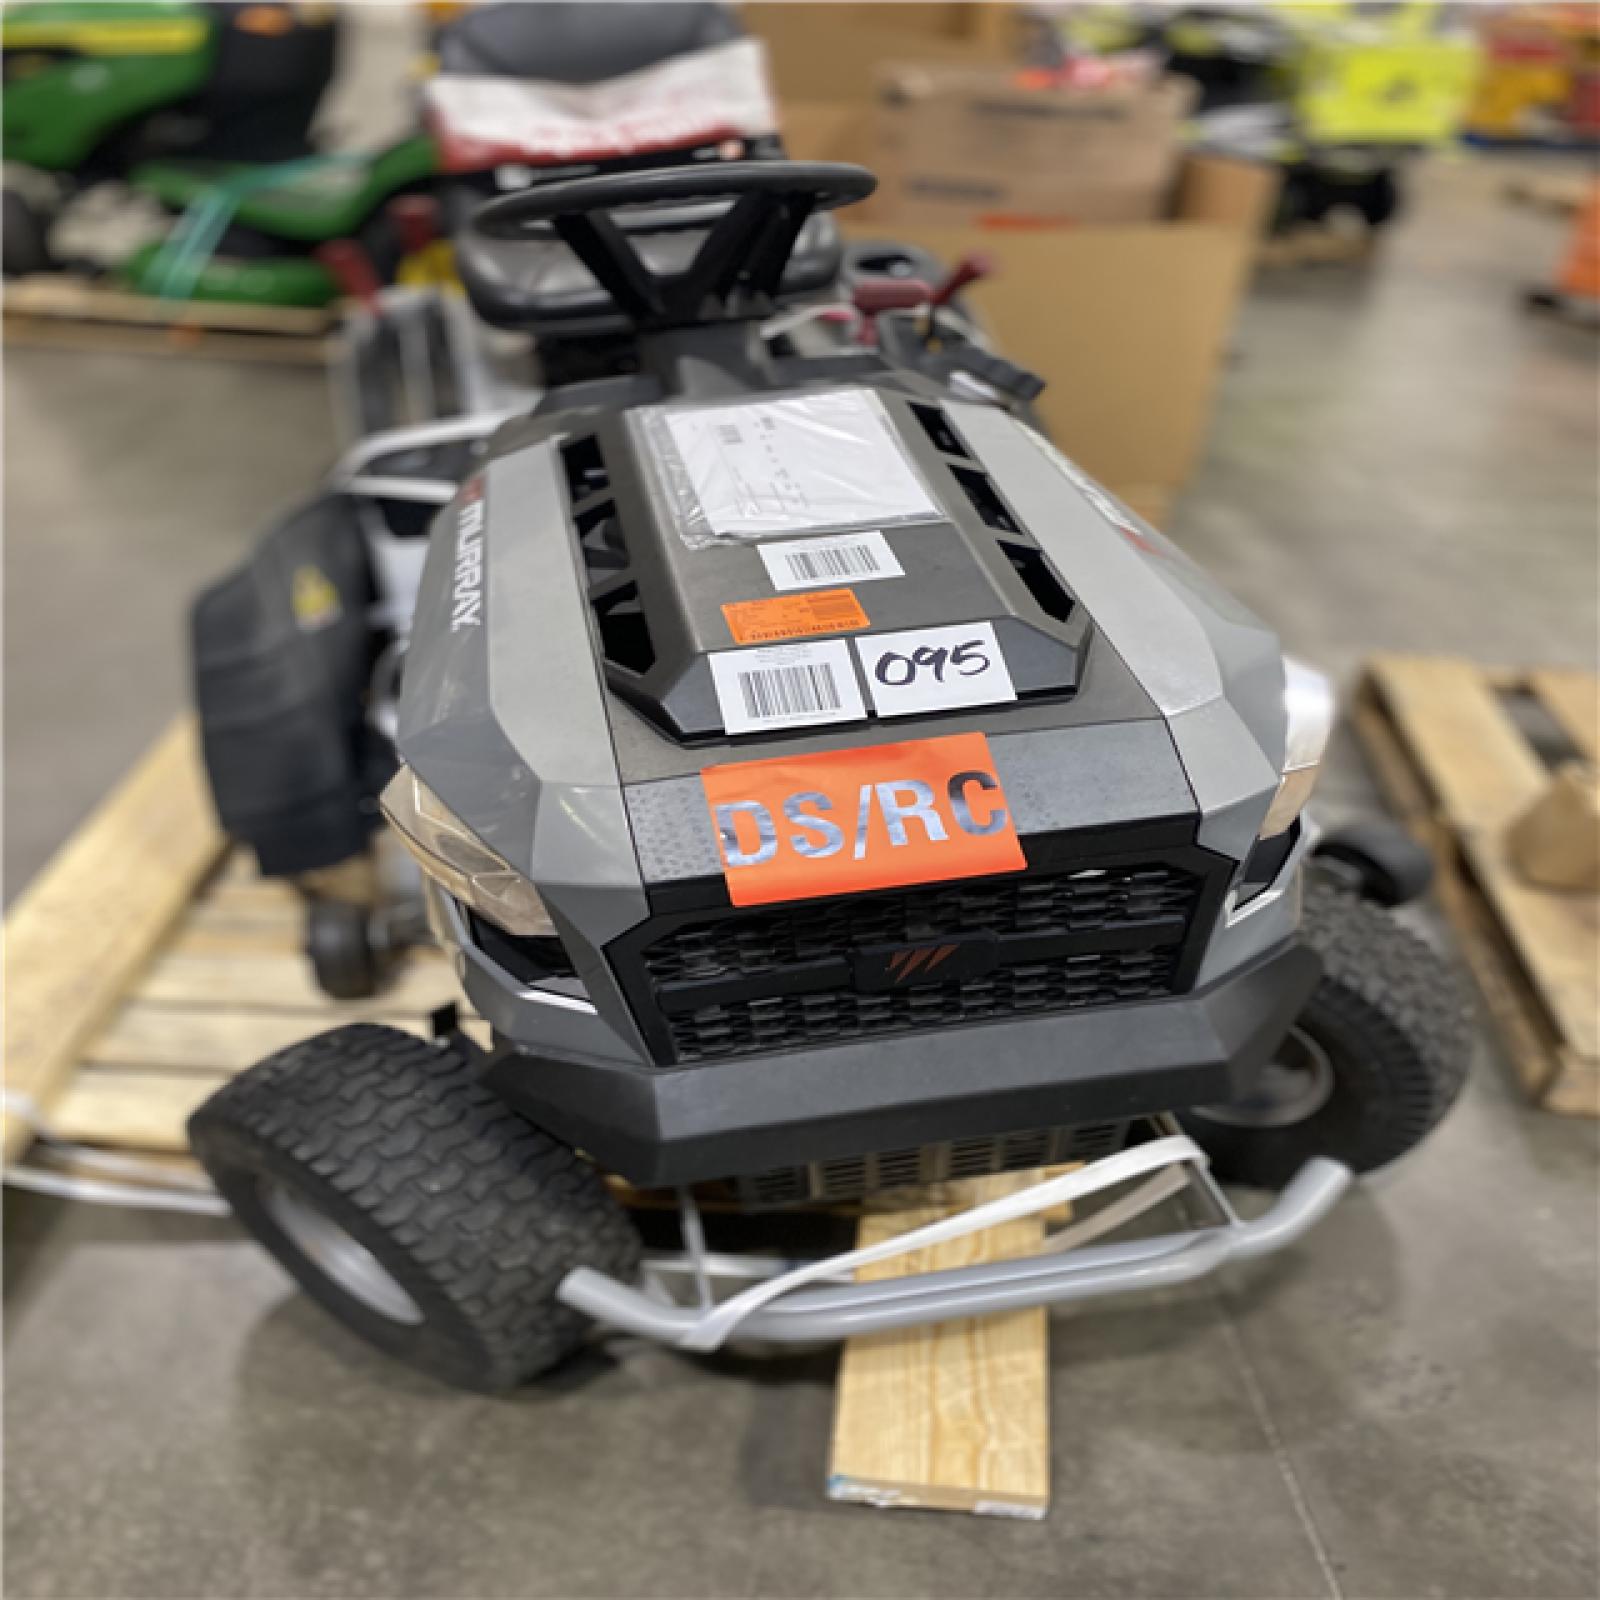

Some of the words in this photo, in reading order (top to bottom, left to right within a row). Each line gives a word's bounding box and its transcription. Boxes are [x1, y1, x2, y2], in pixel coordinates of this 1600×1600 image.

[452, 500, 481, 632] MURRAY
[875, 640, 990, 686] 095
[715, 770, 1007, 867] DS/RC
